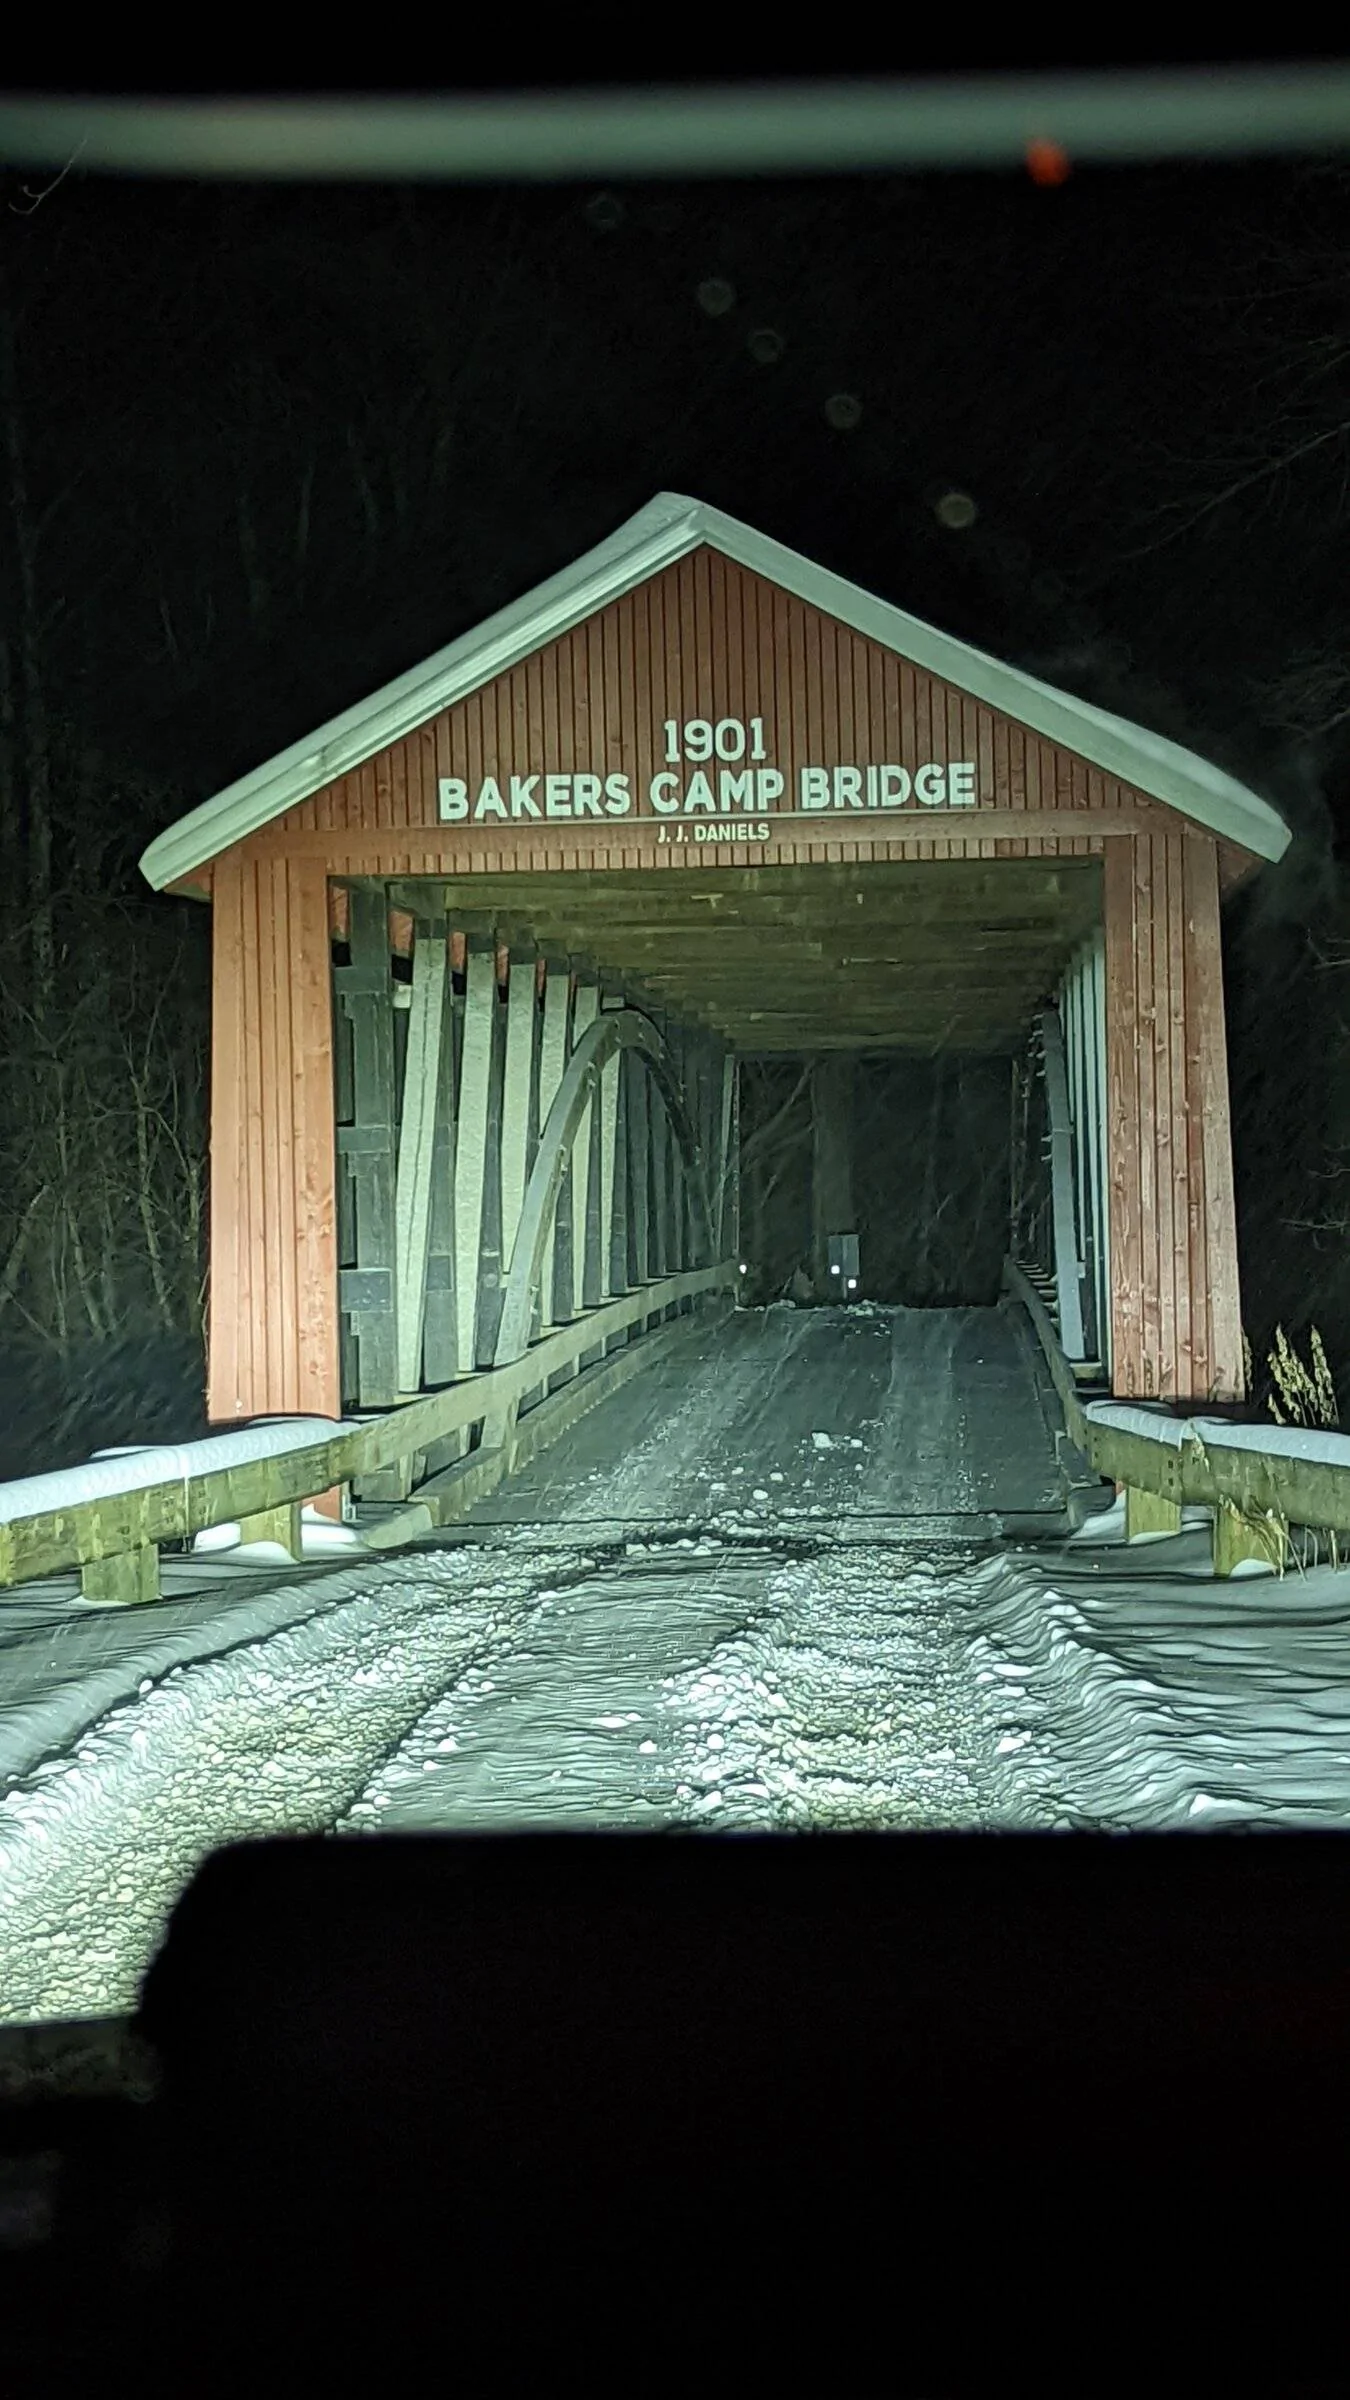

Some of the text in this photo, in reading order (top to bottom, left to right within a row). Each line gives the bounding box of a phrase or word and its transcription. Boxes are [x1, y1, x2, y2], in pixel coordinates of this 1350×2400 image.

[663, 717, 767, 763] 1901
[438, 762, 976, 820] BAKERS CAMP BRIDGE
[694, 822, 770, 842] DANIELS
